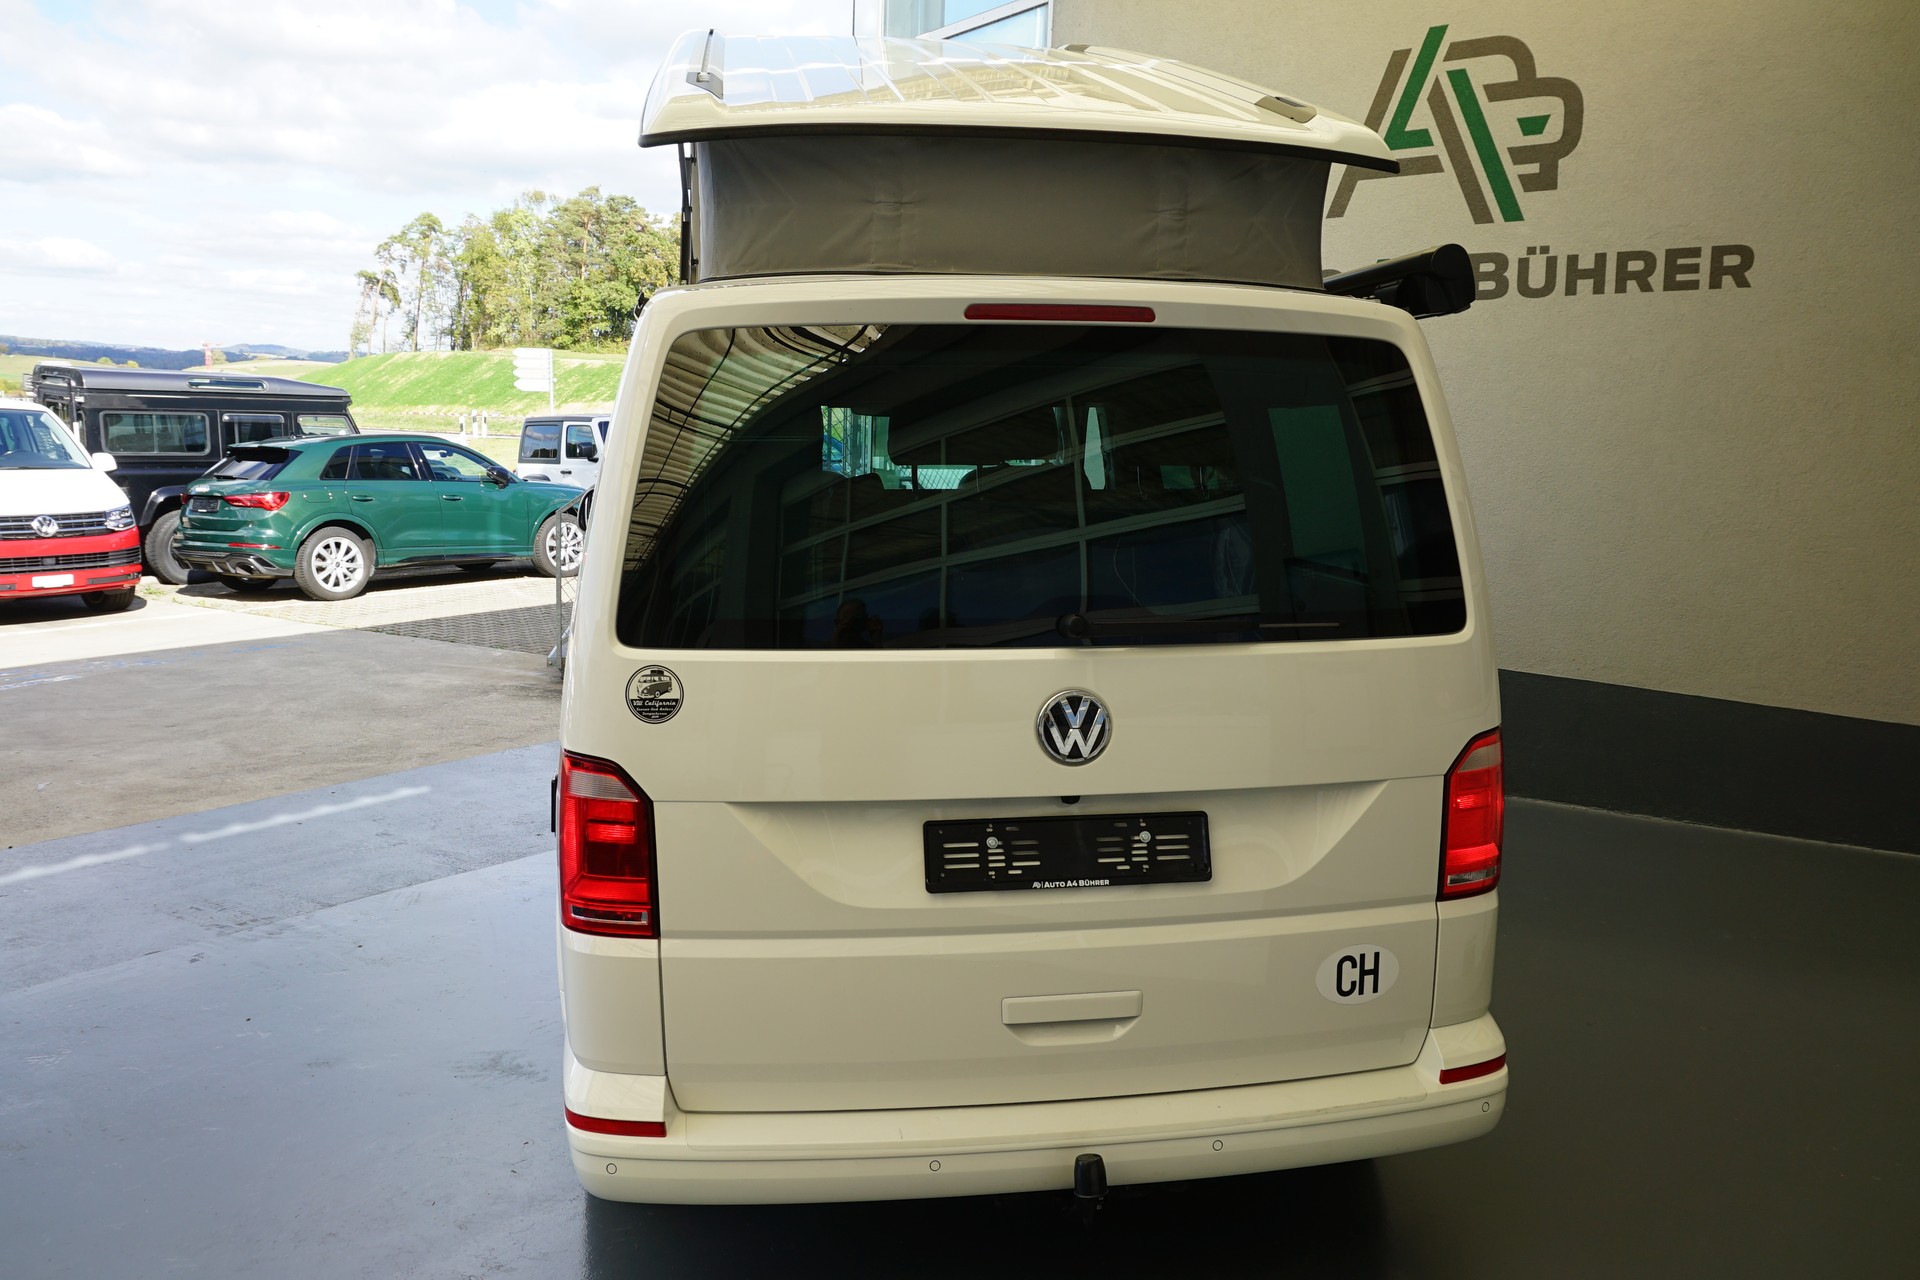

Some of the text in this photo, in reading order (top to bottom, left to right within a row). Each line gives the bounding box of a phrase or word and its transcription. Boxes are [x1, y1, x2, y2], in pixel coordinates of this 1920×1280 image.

[1471, 244, 1755, 301] BÜHRER
[1041, 691, 1109, 763] VW
[1044, 881, 1066, 889] AUTO
[1066, 879, 1078, 888] A4
[1078, 878, 1110, 887] BÜHRER
[1336, 951, 1380, 997] CH
